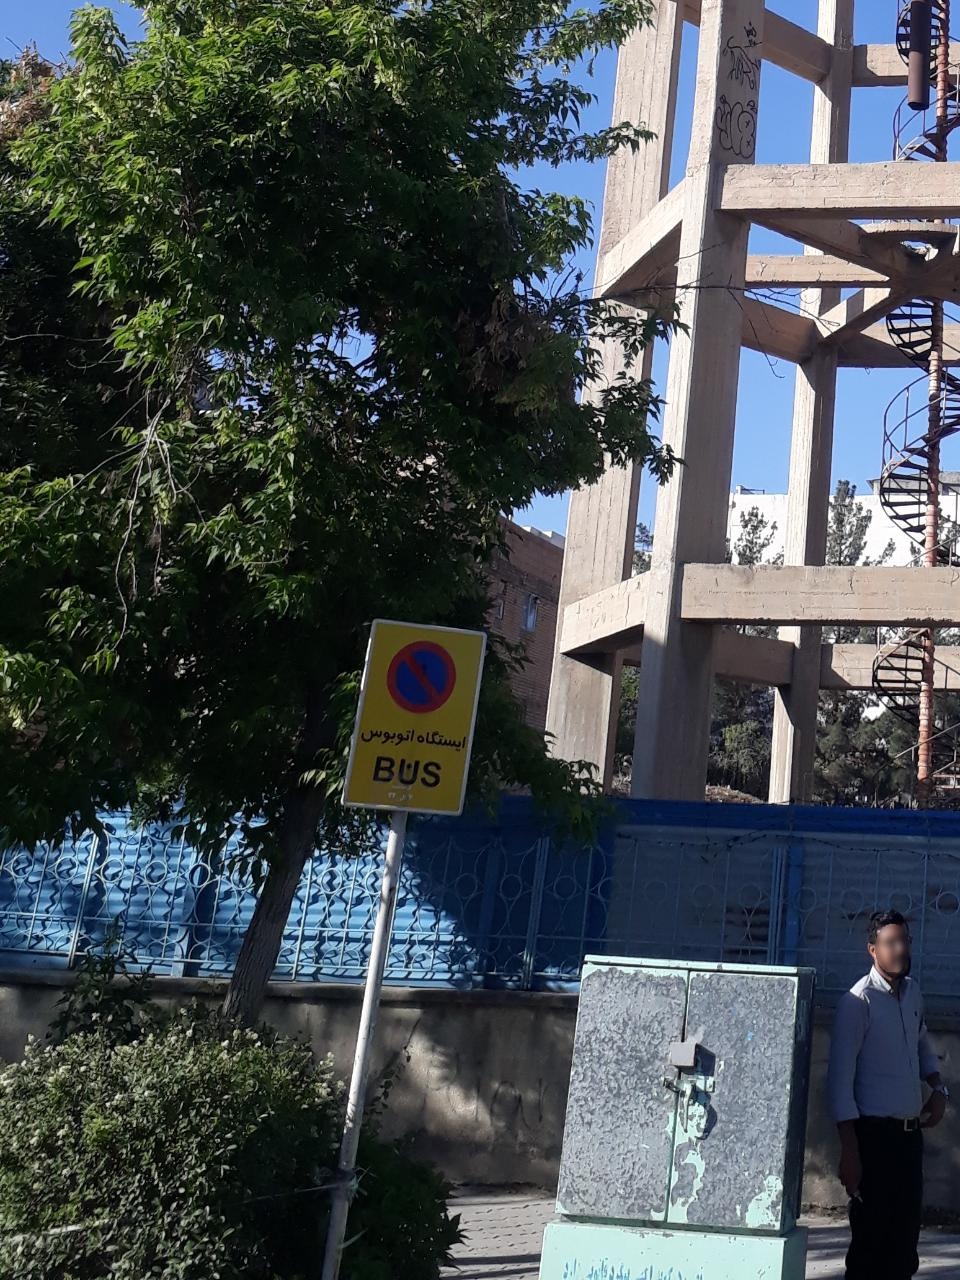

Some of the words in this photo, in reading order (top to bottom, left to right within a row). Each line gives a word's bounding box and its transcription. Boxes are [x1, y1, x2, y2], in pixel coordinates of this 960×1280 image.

[361, 728, 414, 746] اتوبوس
[417, 731, 466, 752] ایستگاه
[372, 755, 442, 788] BUS
